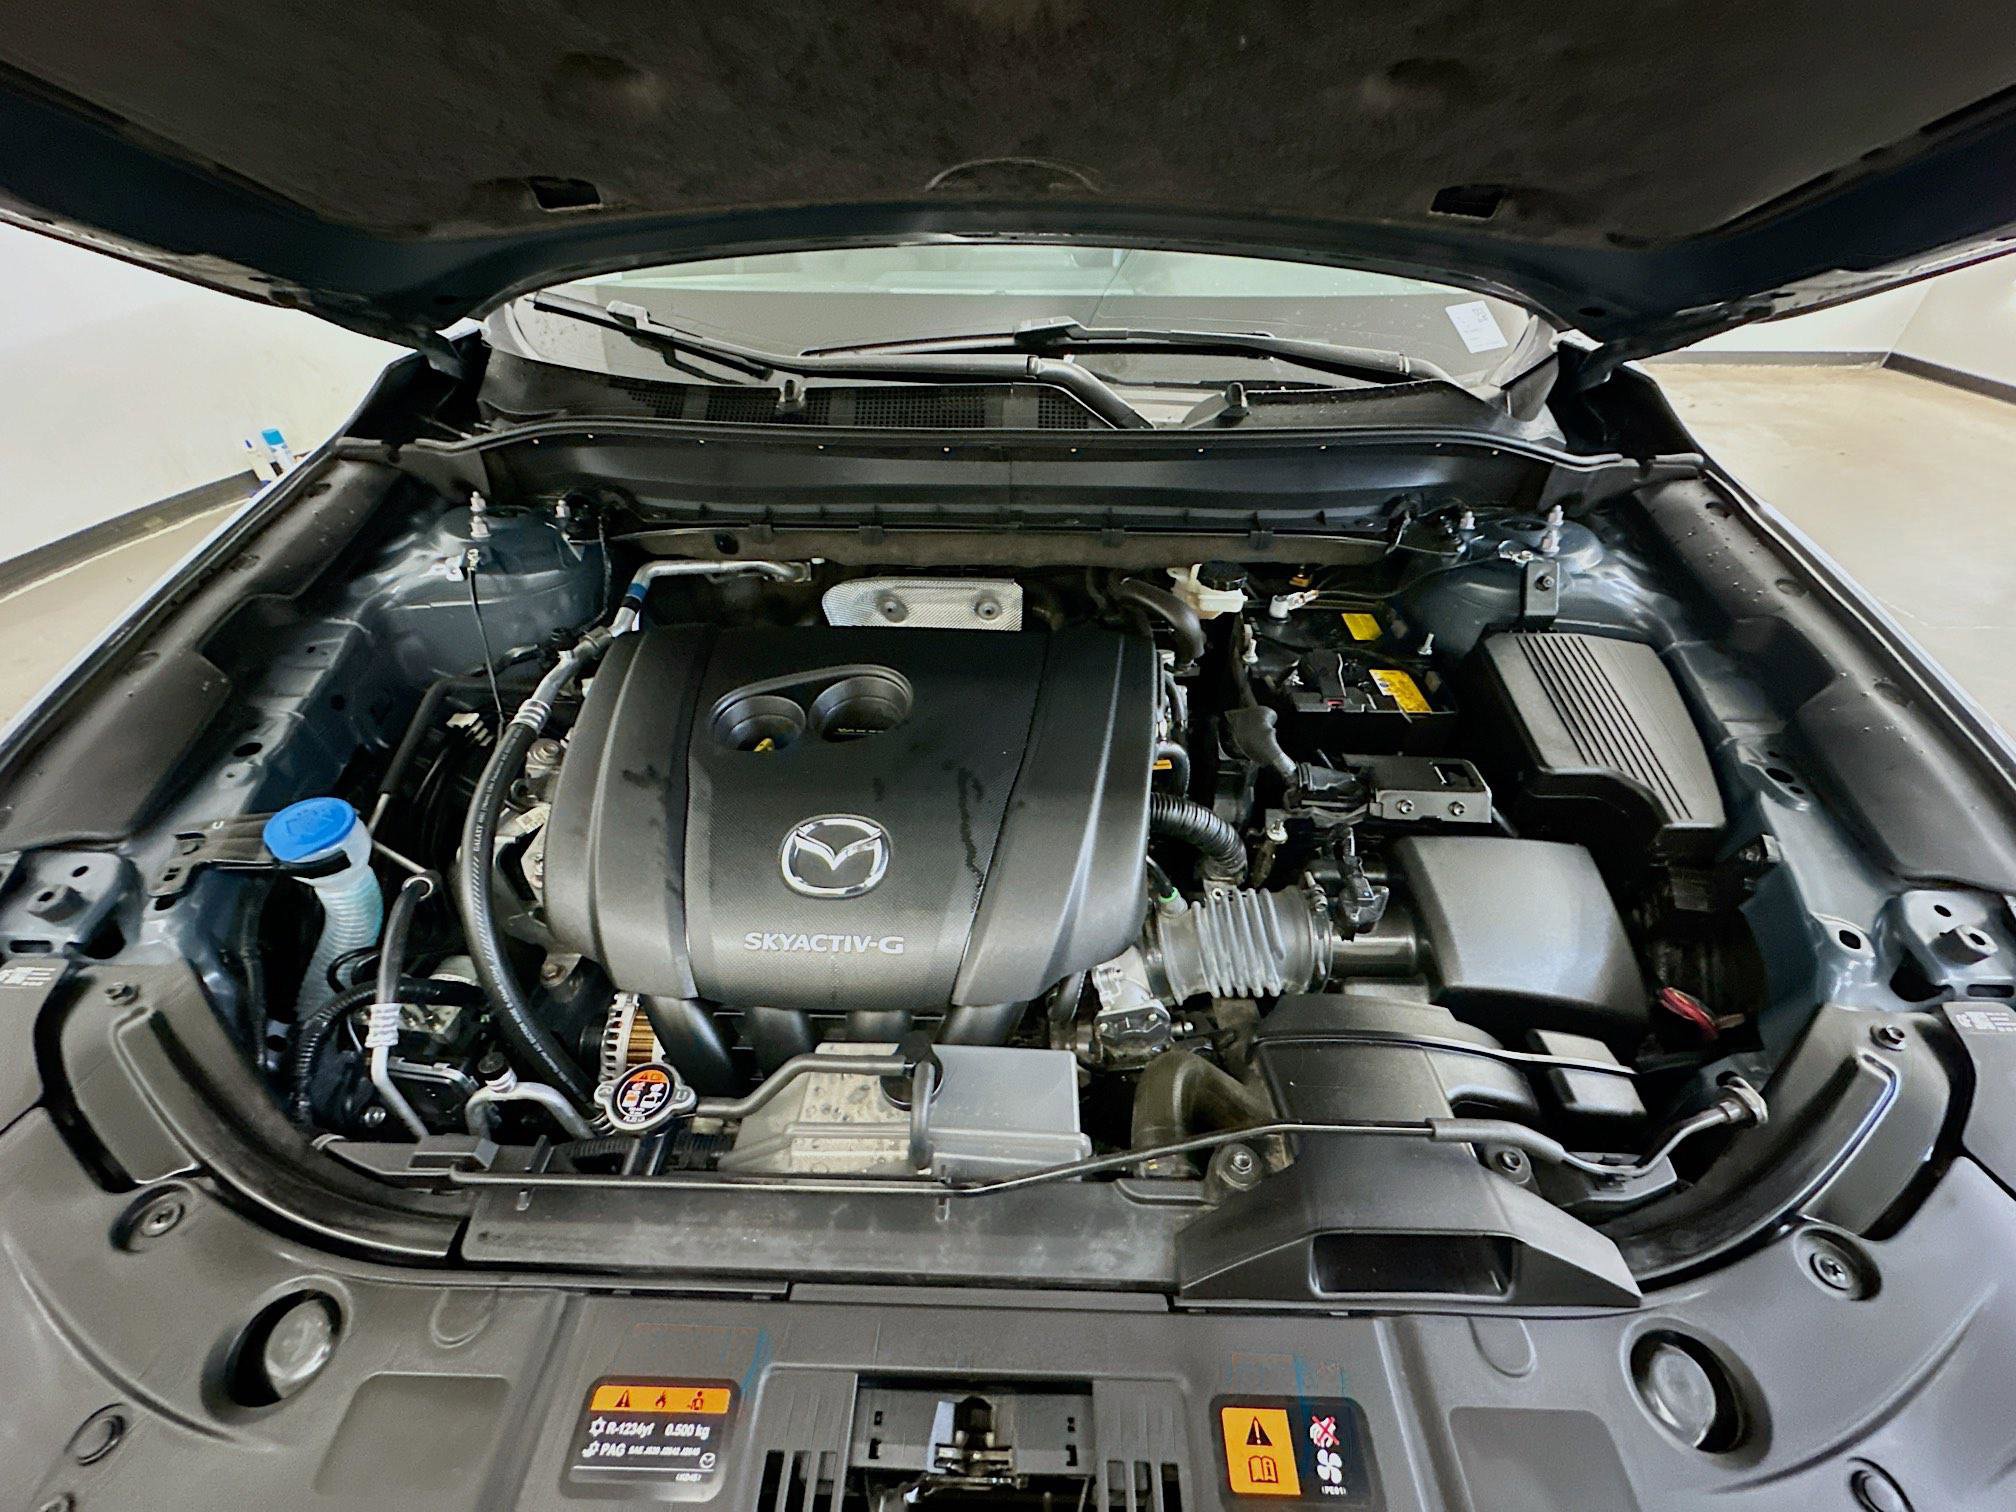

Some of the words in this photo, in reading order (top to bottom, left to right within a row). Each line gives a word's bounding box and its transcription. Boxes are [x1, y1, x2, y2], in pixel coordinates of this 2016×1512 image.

[473, 825, 484, 852] GALAXY
[744, 932, 904, 954] SKYACTIV-G
[606, 1421, 655, 1438] R-1234yf
[665, 1423, 694, 1437] 0.500
[695, 1424, 710, 1440] kg
[599, 1443, 626, 1457] PAG
